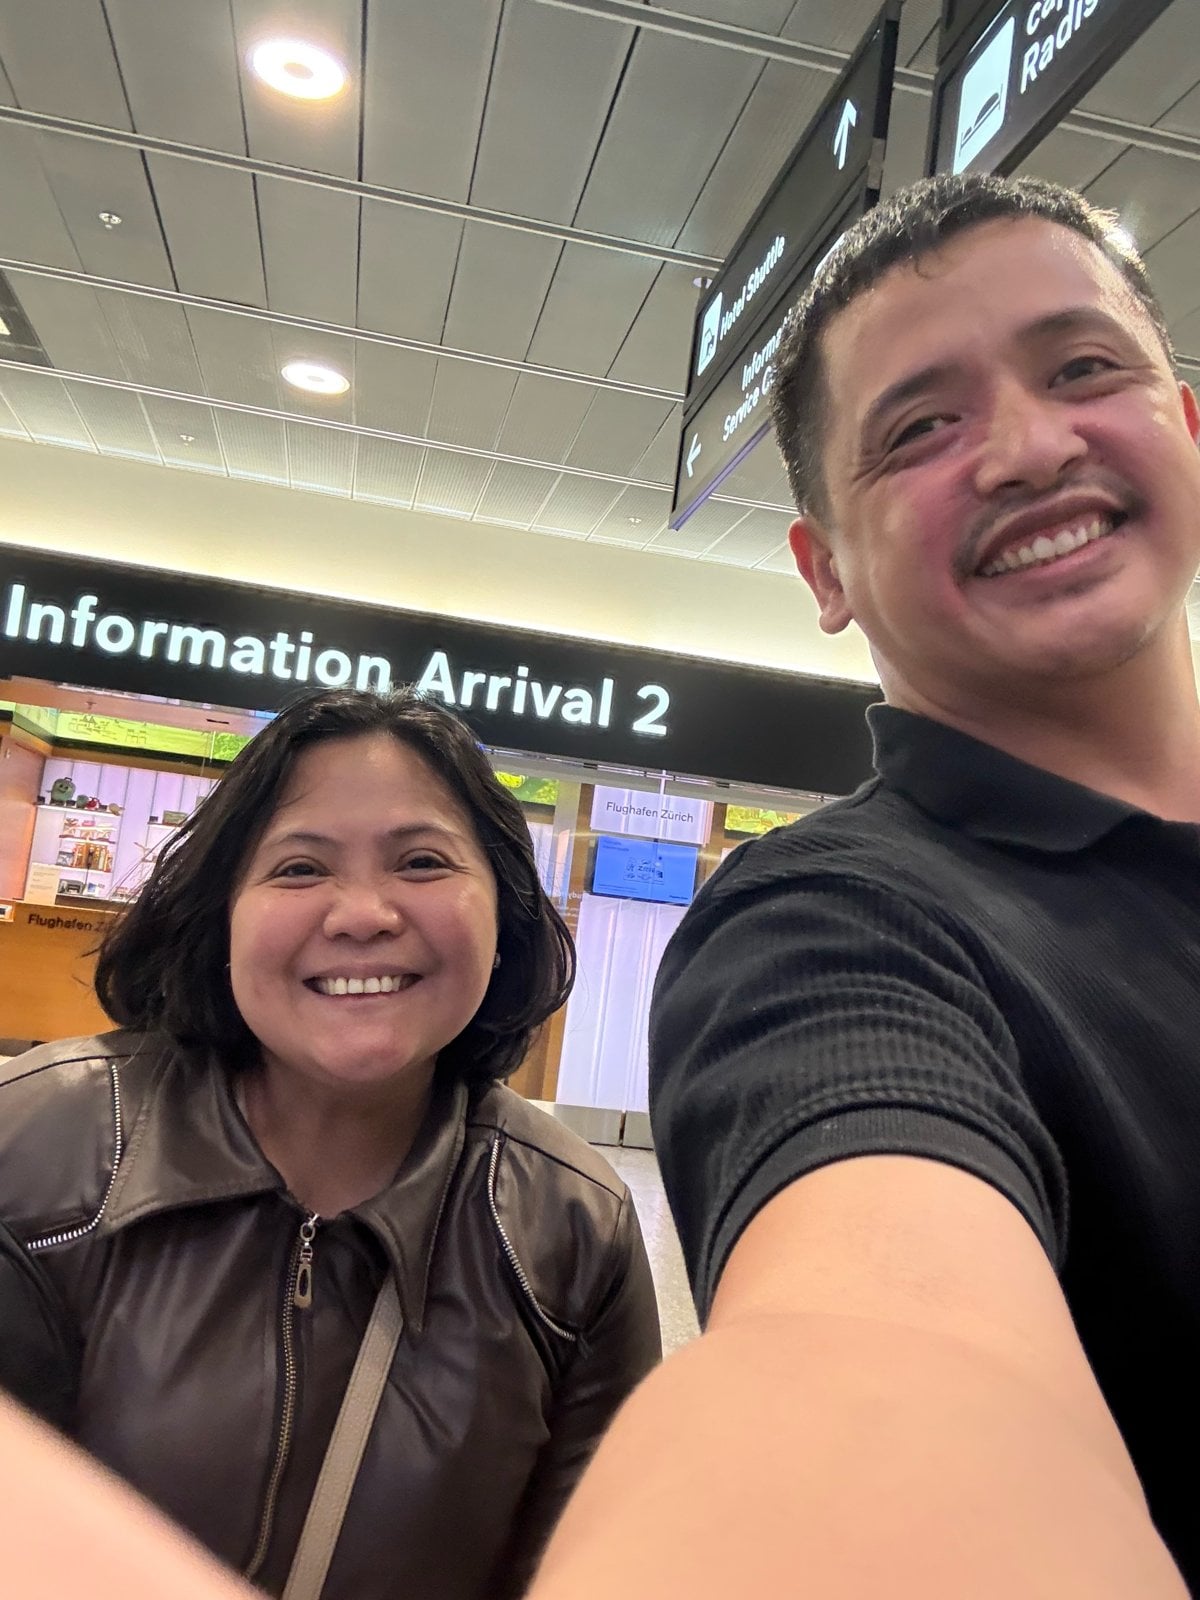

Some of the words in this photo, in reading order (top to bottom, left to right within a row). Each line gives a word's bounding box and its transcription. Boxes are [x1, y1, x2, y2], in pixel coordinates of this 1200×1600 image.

[720, 285, 746, 341] Hotel
[746, 236, 785, 301] Shuttle
[723, 386, 760, 441] Service
[3, 583, 391, 694] Information
[413, 651, 613, 728] Arrival
[632, 684, 670, 735] 2
[606, 801, 658, 818] Flughafen
[660, 808, 694, 823] Zürich
[28, 914, 92, 931] Flughafen
